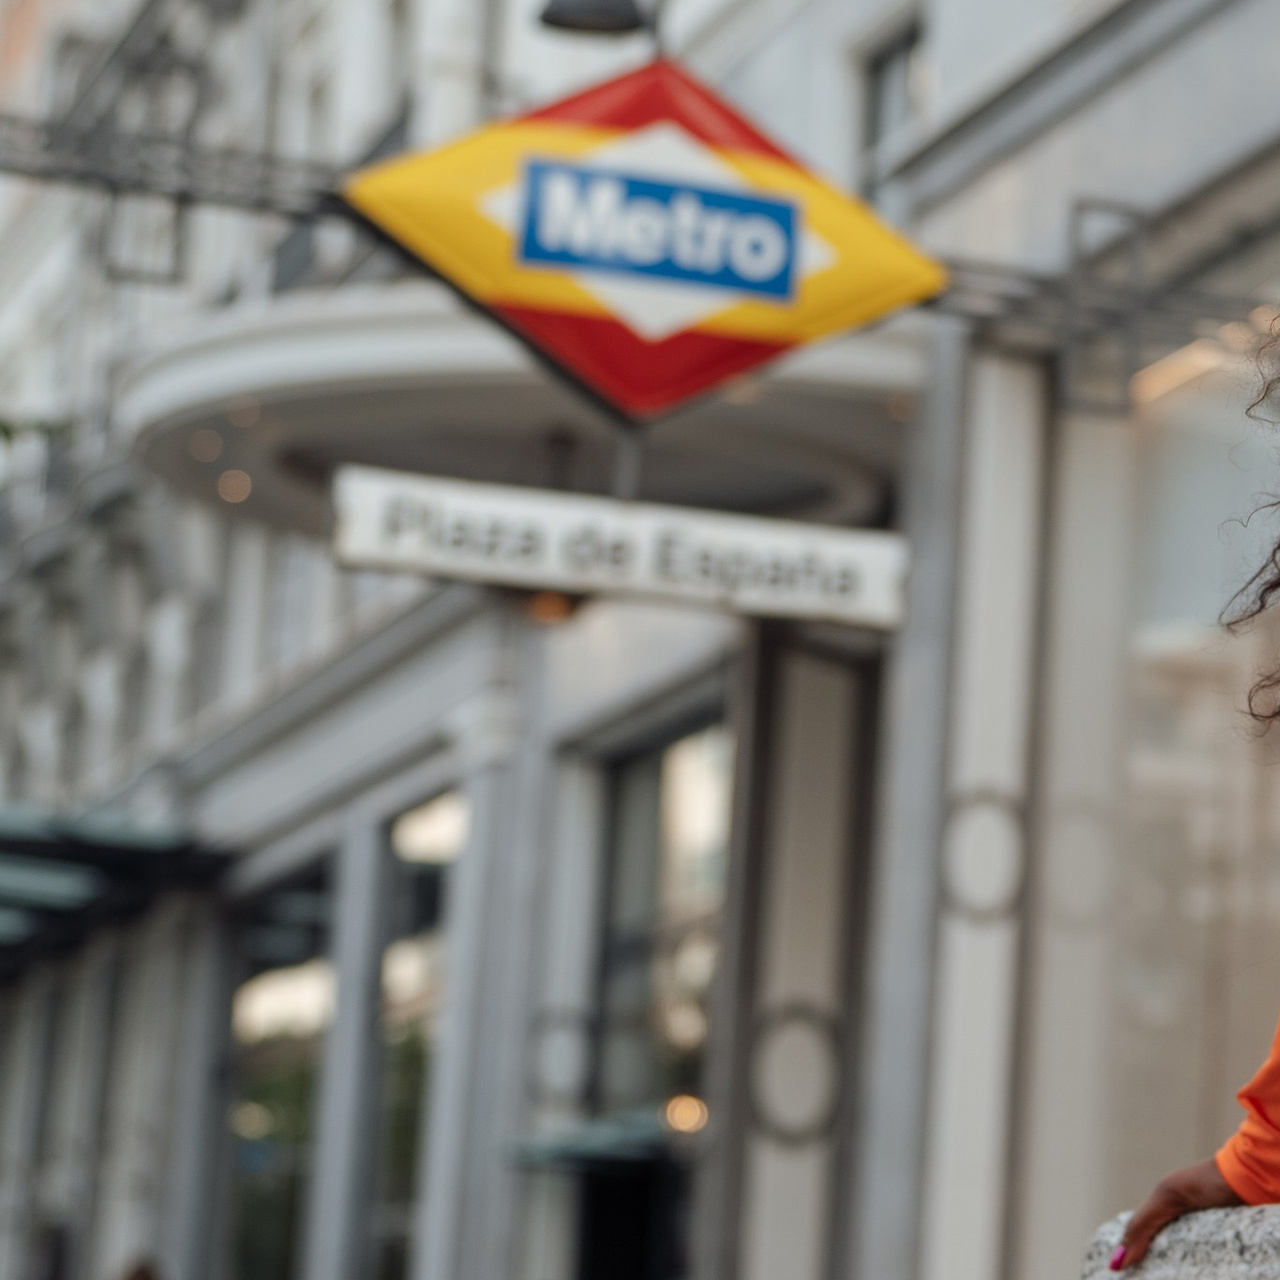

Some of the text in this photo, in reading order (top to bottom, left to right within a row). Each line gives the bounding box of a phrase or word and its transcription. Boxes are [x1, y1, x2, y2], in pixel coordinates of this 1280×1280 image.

[538, 170, 787, 282] Metro
[382, 496, 862, 599] Plaza de España
